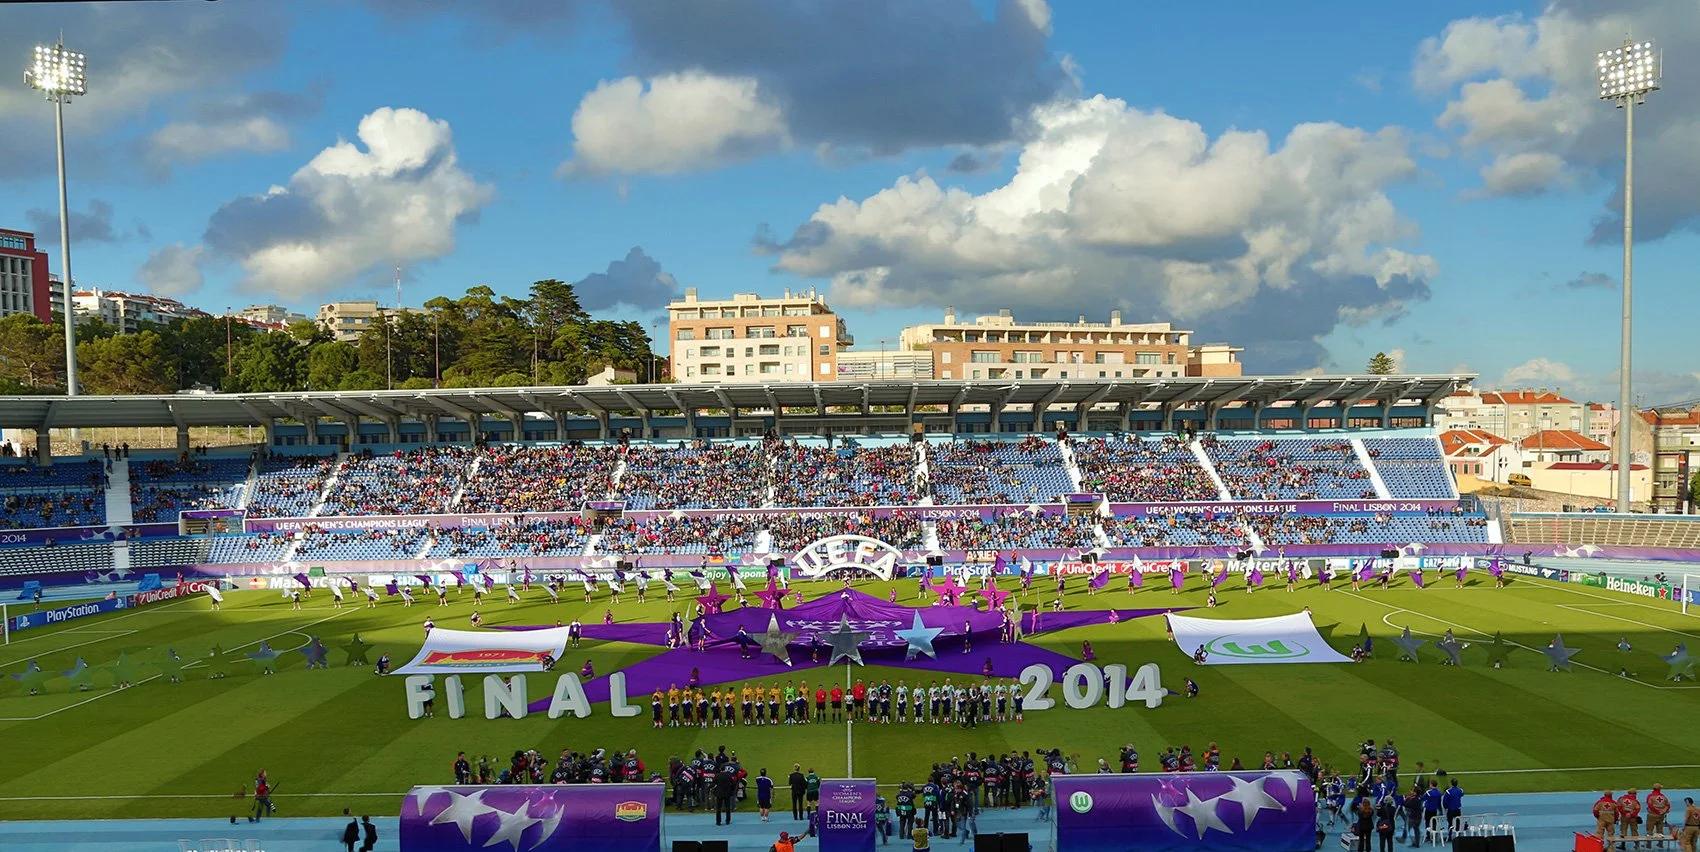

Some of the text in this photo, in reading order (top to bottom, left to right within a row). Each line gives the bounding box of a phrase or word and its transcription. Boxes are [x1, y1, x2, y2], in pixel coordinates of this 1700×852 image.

[1264, 504, 1297, 513] LEAUE
[1333, 502, 1421, 512] FINAL LISBON 2014
[275, 521, 301, 531] UEFA
[345, 519, 397, 529] CHAMPIONS
[462, 516, 488, 527] FINAL
[1, 533, 27, 544] 2014
[795, 540, 898, 581] UEFA
[1508, 564, 1538, 576] MUSTANG
[1606, 576, 1655, 598] Heineken
[146, 587, 178, 604] UniCredit
[46, 603, 100, 623] PlayStation
[1019, 662, 1168, 711] 2014
[405, 671, 642, 720] FINAL
[826, 810, 867, 824] FINAL
